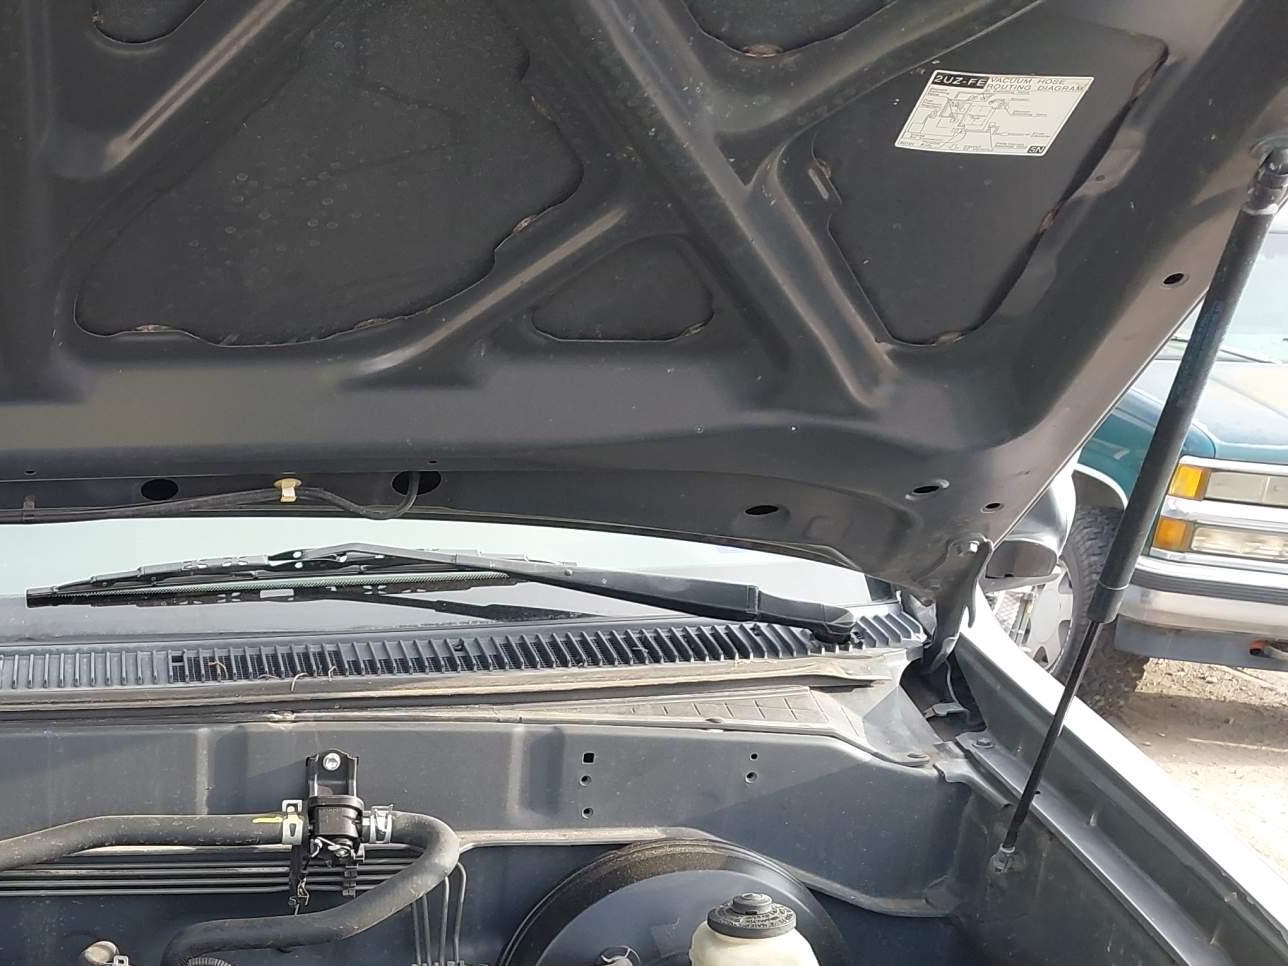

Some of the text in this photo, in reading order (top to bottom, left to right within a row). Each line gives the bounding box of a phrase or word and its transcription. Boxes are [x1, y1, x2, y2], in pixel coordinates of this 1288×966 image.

[933, 74, 1065, 88] 2UZ-FE VACUUM HOSE
[986, 83, 1085, 93] ROUTING DIAGRAM
